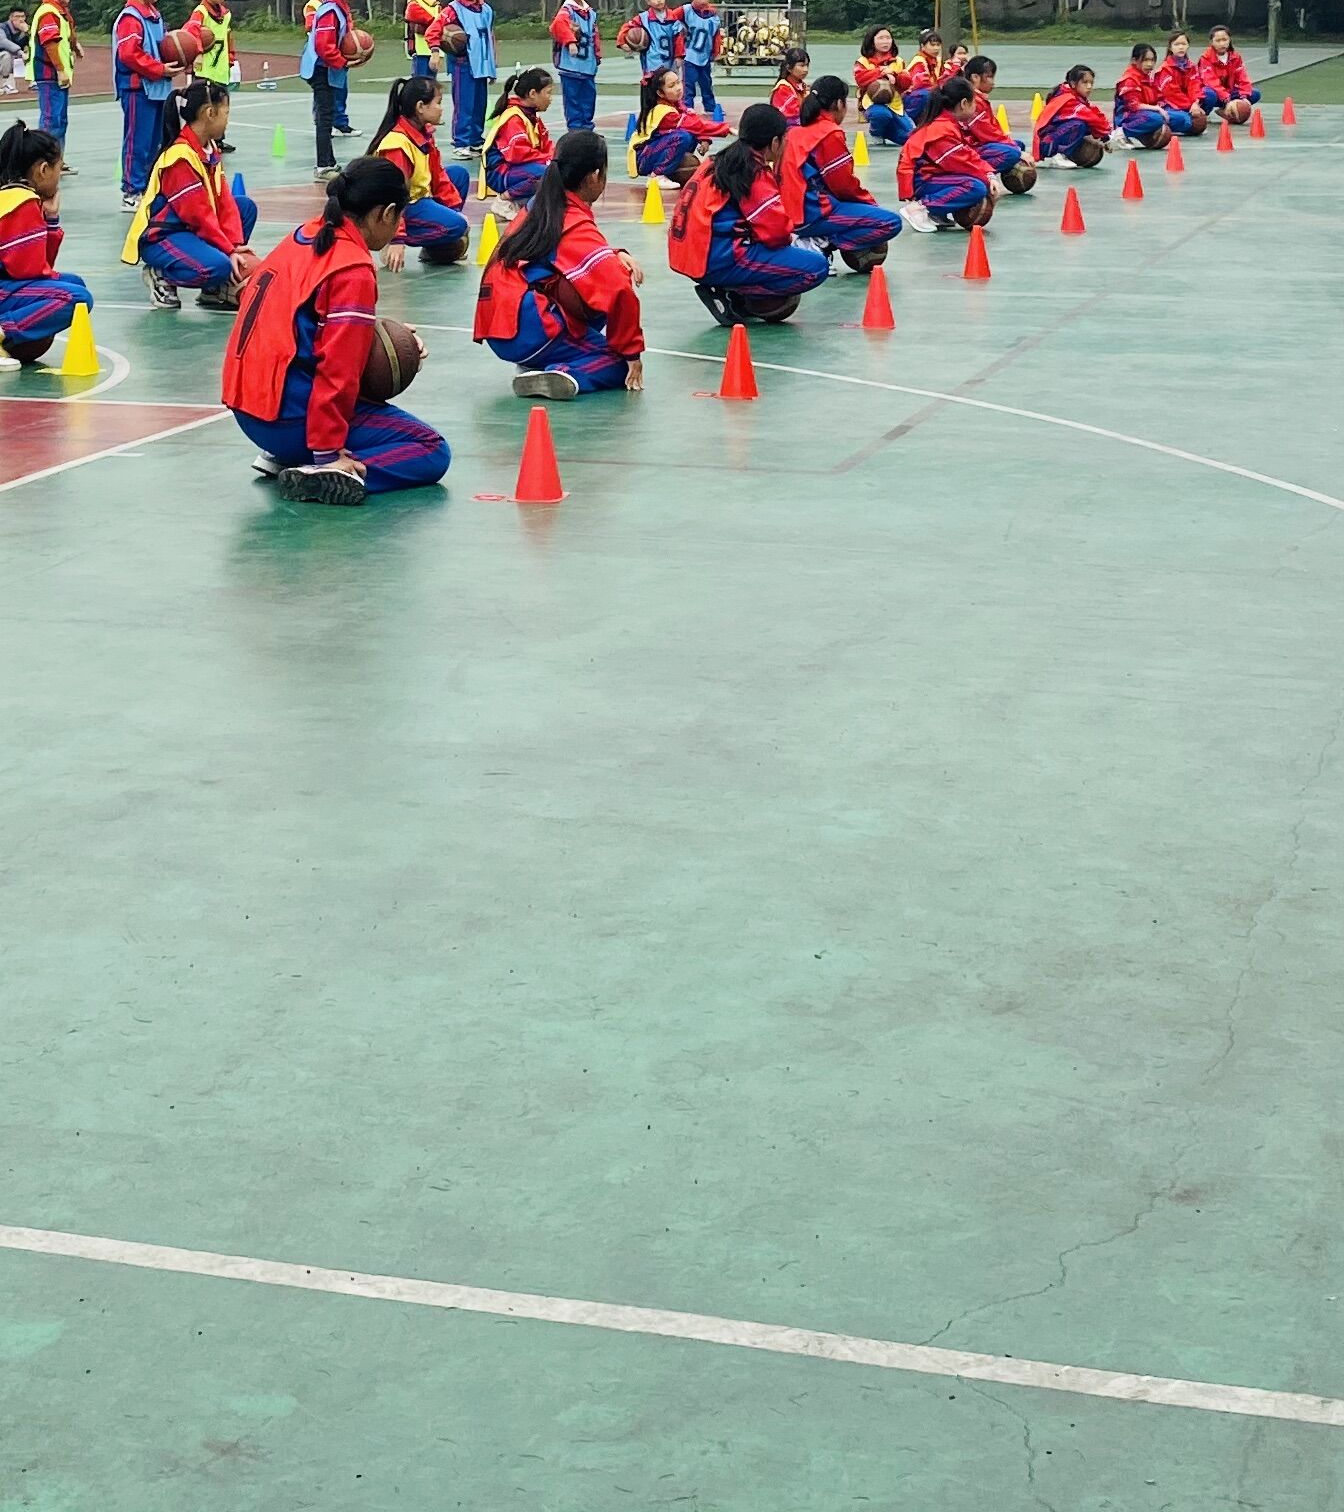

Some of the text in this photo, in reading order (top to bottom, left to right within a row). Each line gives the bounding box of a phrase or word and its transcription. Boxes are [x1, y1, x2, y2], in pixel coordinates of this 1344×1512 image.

[212, 39, 225, 68] 7
[658, 36, 671, 60] 9
[236, 268, 279, 359] 1
